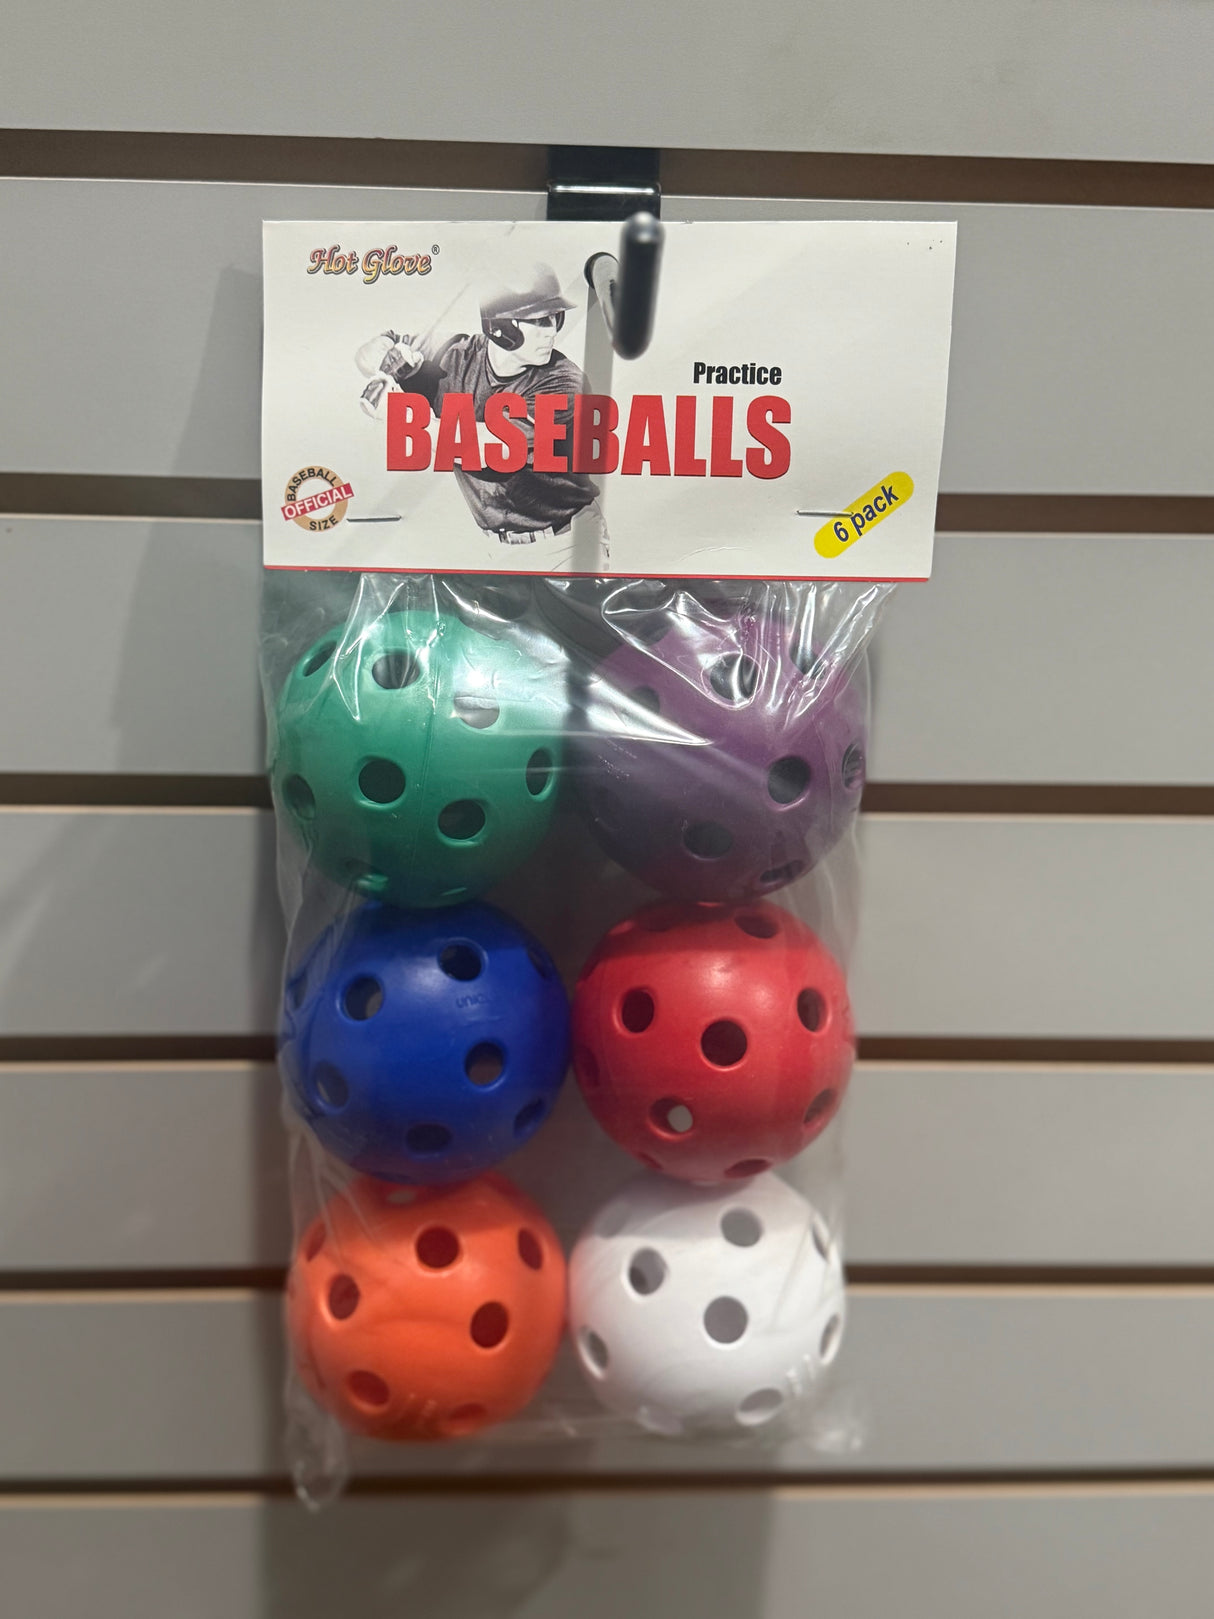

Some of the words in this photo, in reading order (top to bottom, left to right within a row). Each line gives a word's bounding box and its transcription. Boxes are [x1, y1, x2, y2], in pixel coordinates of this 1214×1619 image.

[307, 244, 359, 275] Hot
[693, 361, 782, 386] Practice
[386, 392, 792, 480] BASEBALLS
[287, 467, 337, 502] BASEBALL
[284, 486, 353, 518] OFFICIAL
[833, 521, 850, 542] 6
[850, 485, 900, 537] pack
[309, 515, 339, 531] SIZE
